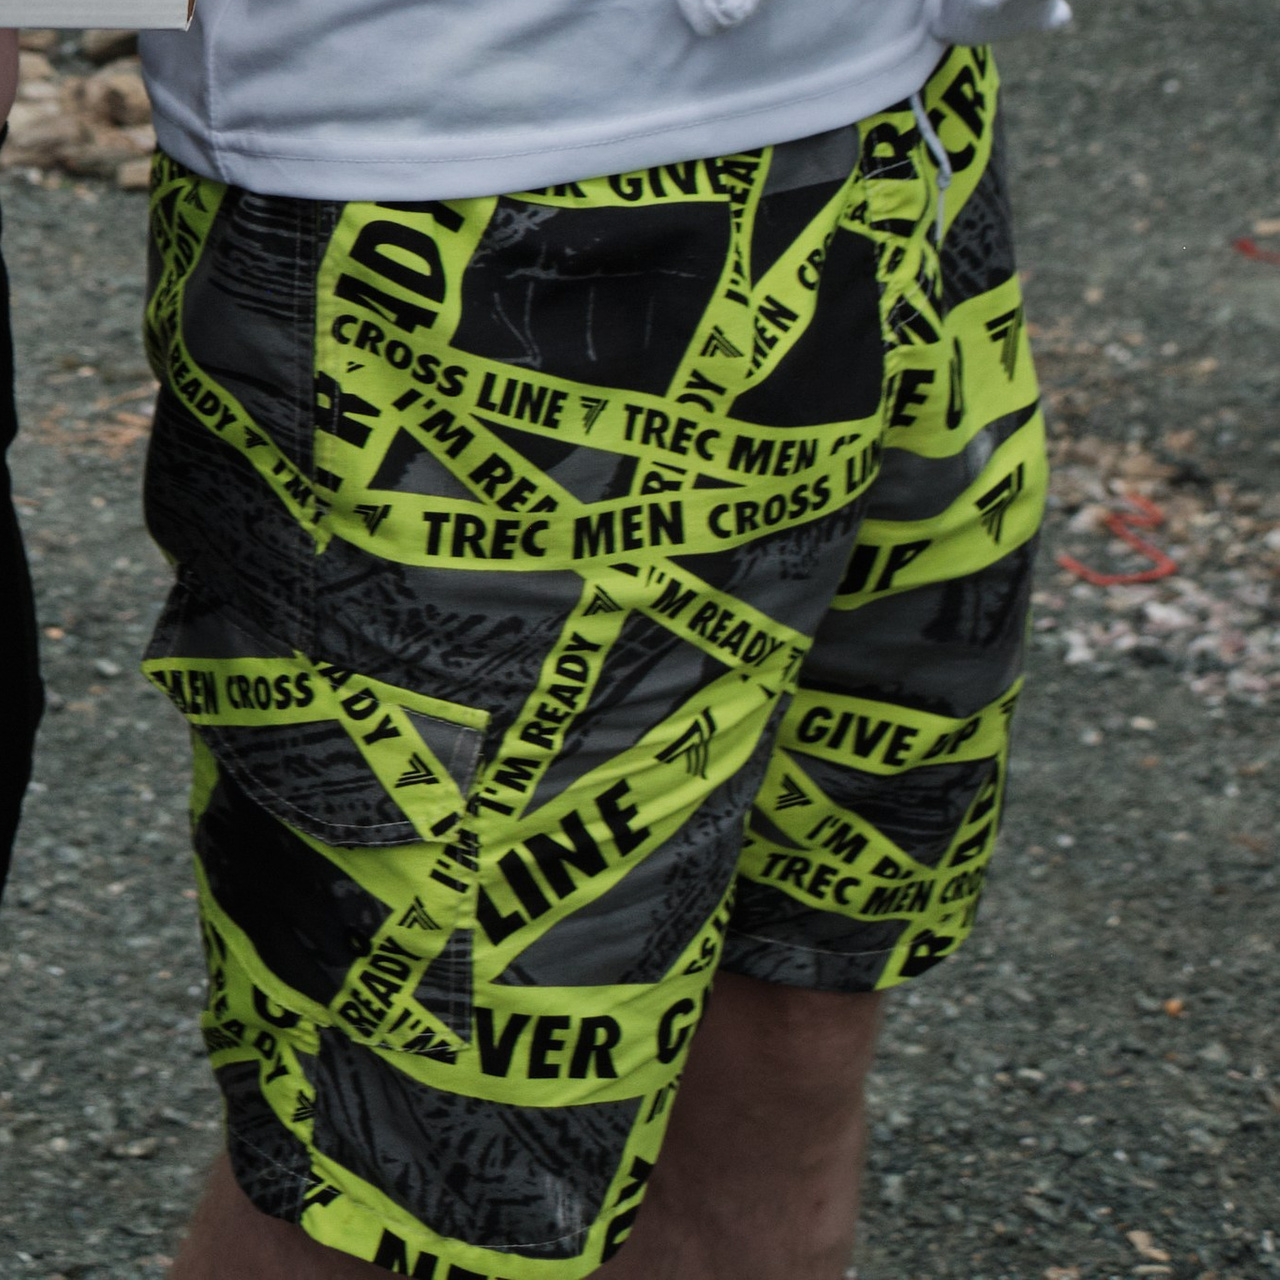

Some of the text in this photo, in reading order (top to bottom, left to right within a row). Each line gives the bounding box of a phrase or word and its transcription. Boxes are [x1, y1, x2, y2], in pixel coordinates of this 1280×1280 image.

[331, 313, 469, 398] CROSS
[475, 372, 570, 430] LINE
[623, 402, 722, 462] TREC
[727, 434, 820, 477] MEN
[391, 387, 475, 460] I'M
[423, 510, 551, 560] TREC
[572, 500, 686, 560] MEN
[707, 474, 832, 539] CROSS
[687, 600, 785, 667] READY
[225, 672, 316, 711] CROSS
[479, 631, 604, 817] I'M READY
[795, 705, 920, 768] GIVE
[475, 778, 651, 947] LINE
[807, 813, 870, 866] I'M
[759, 851, 862, 906] TREC
[860, 878, 936, 917] MEN
[338, 935, 422, 1039] READY
